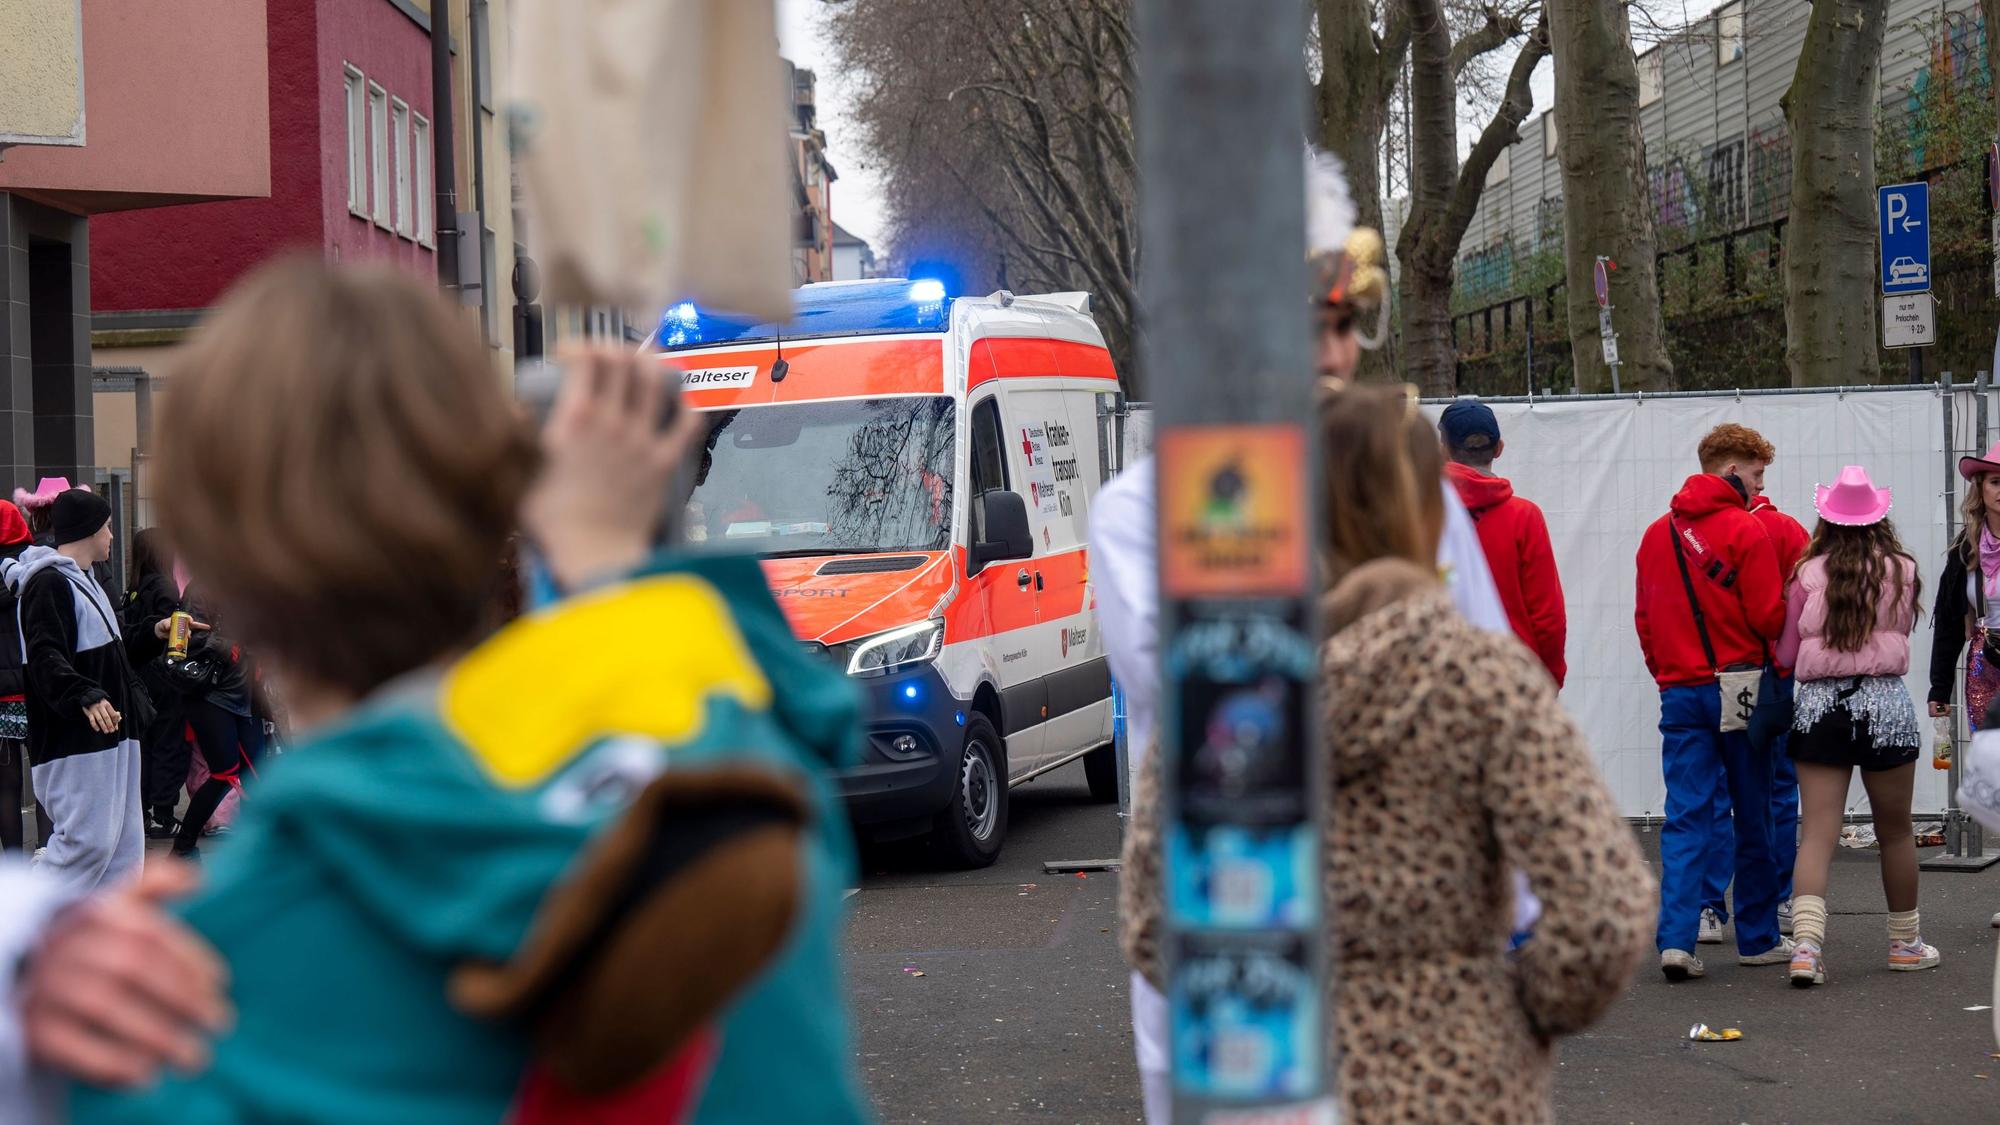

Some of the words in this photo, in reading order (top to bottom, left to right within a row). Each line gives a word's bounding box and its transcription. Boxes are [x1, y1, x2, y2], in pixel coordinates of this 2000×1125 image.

[1887, 193, 1907, 235] P
[1907, 302, 1915, 310] mit
[1051, 452, 1080, 487] transport
[1037, 480, 1055, 498] Malteser
[1068, 625, 1087, 648] Malteser
